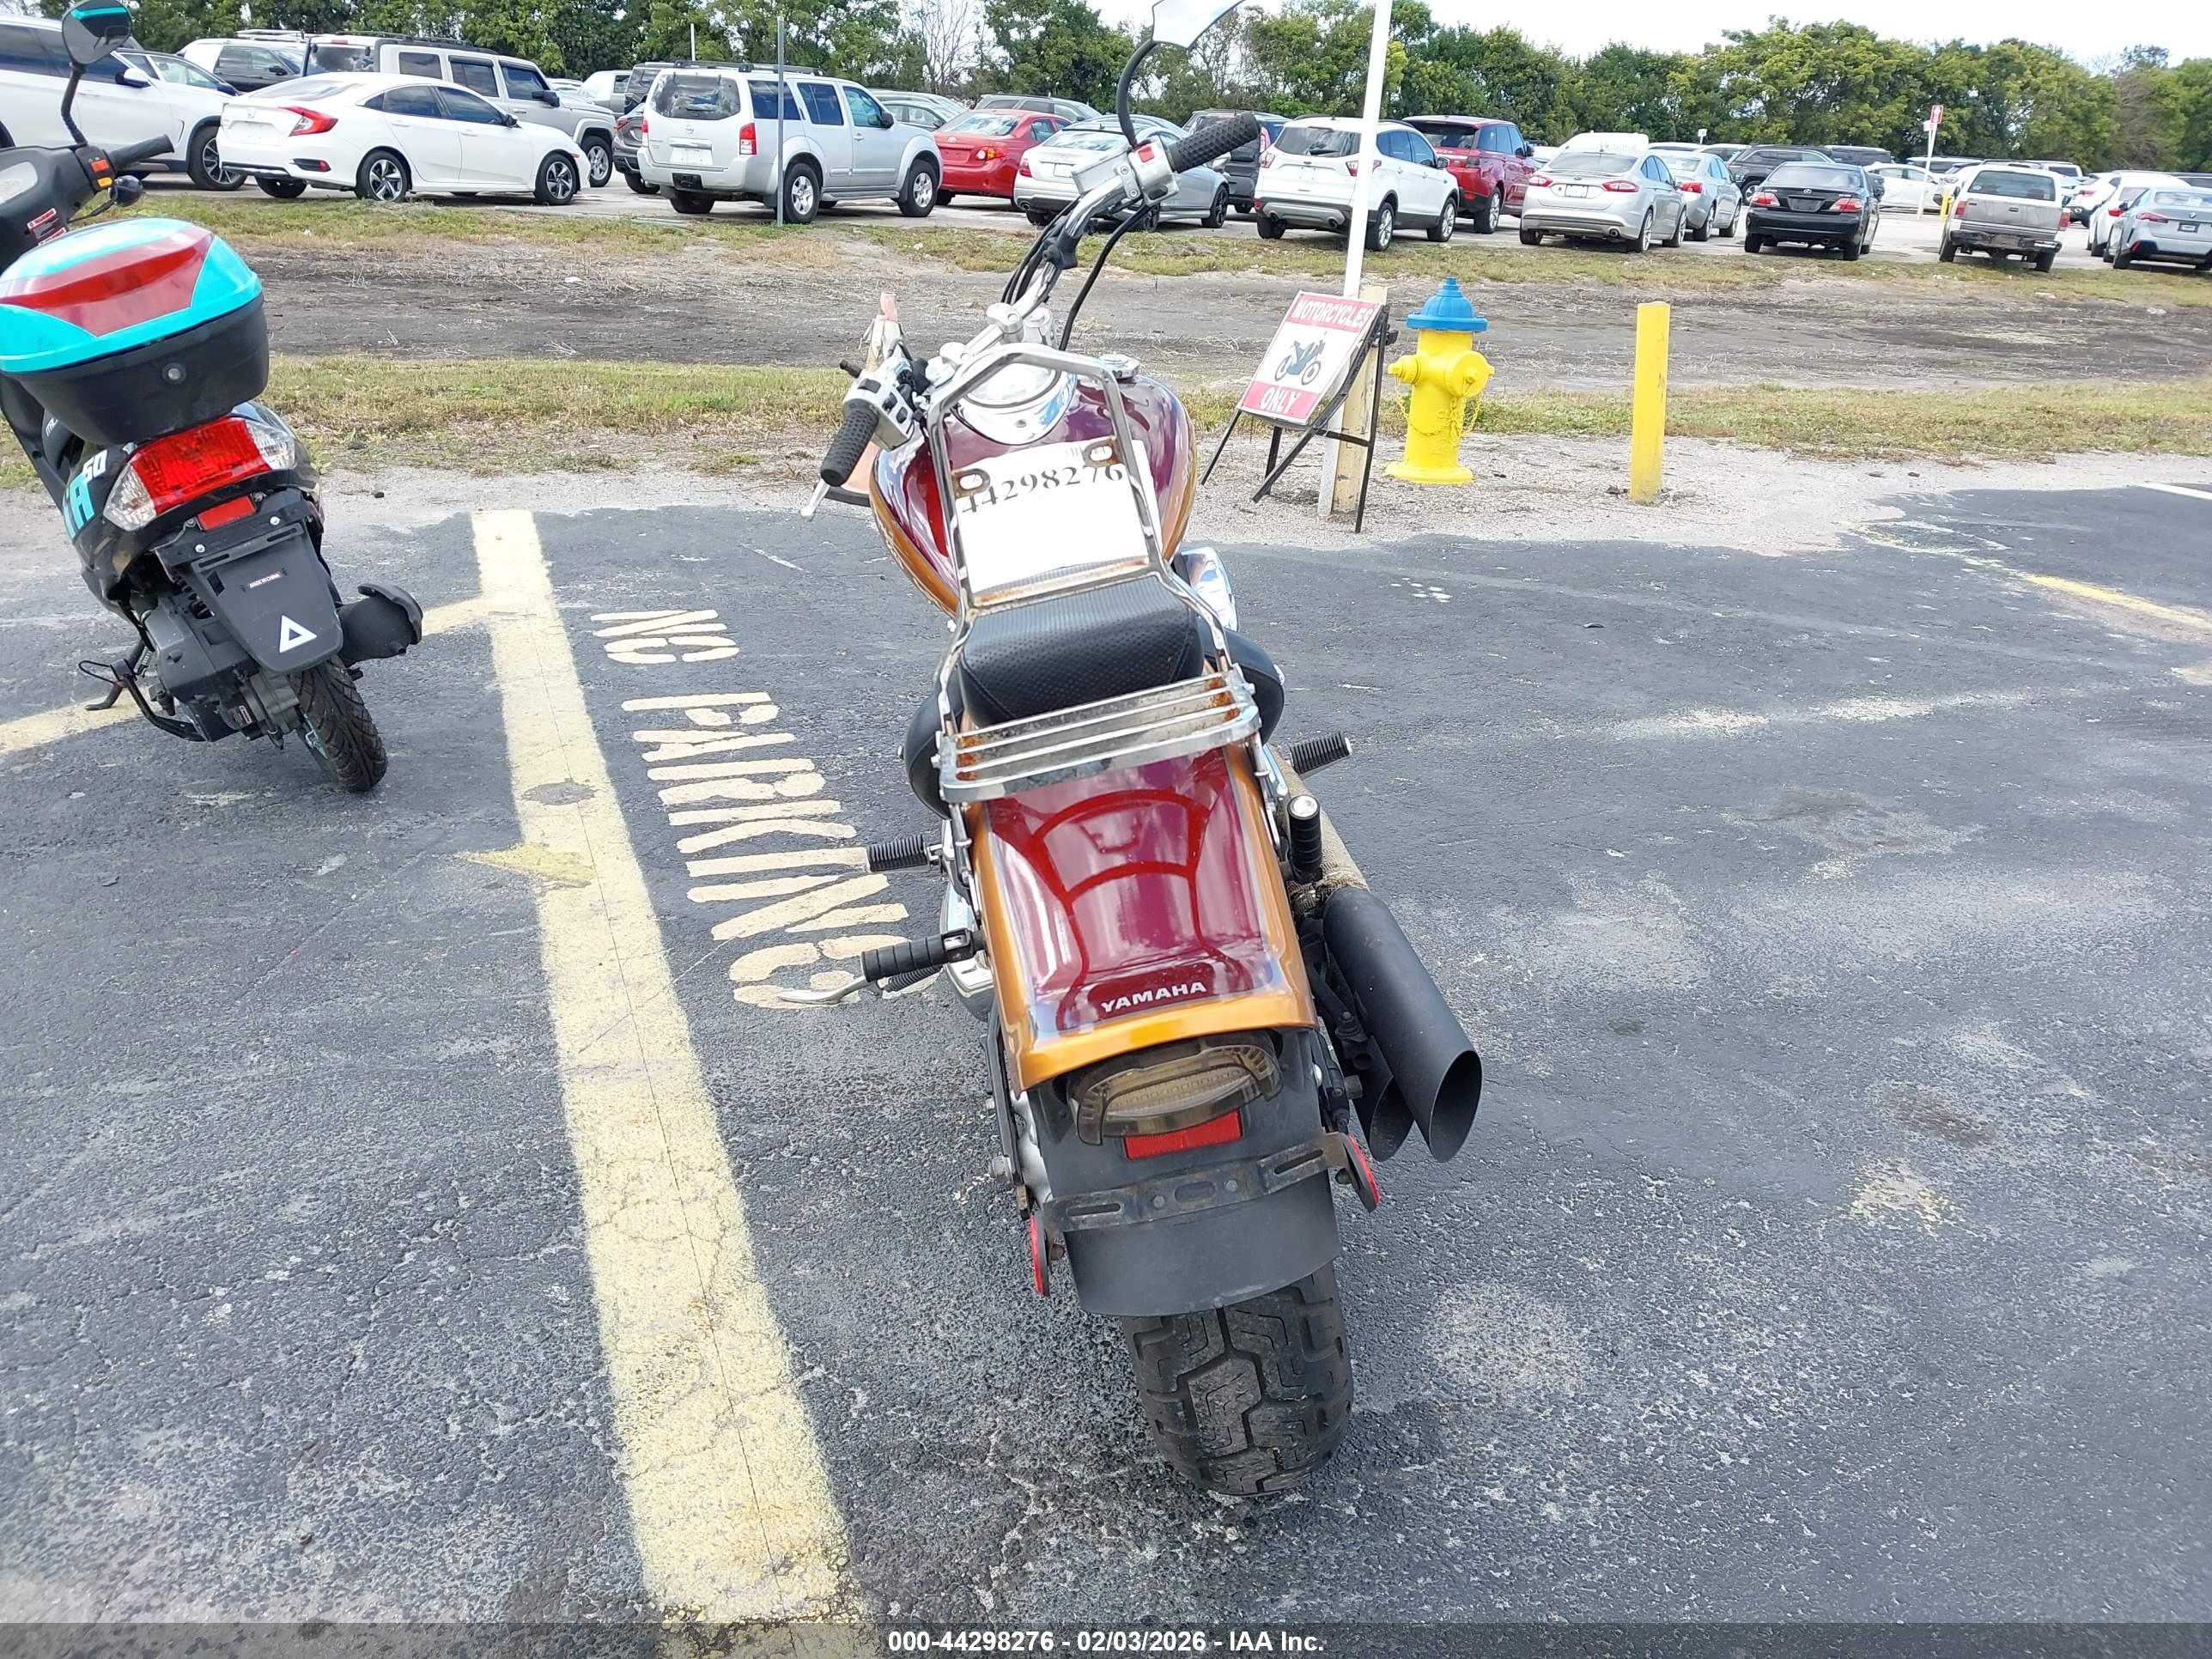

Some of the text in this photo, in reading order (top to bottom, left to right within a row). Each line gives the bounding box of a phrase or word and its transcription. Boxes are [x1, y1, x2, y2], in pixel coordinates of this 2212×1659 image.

[1291, 300, 1374, 330] MOTORCYCLES
[1260, 386, 1303, 414] ONLY
[962, 465, 1123, 513] 44298276
[590, 609, 942, 1010] NO PARKING
[1100, 981, 1207, 1013] YAMAHA
